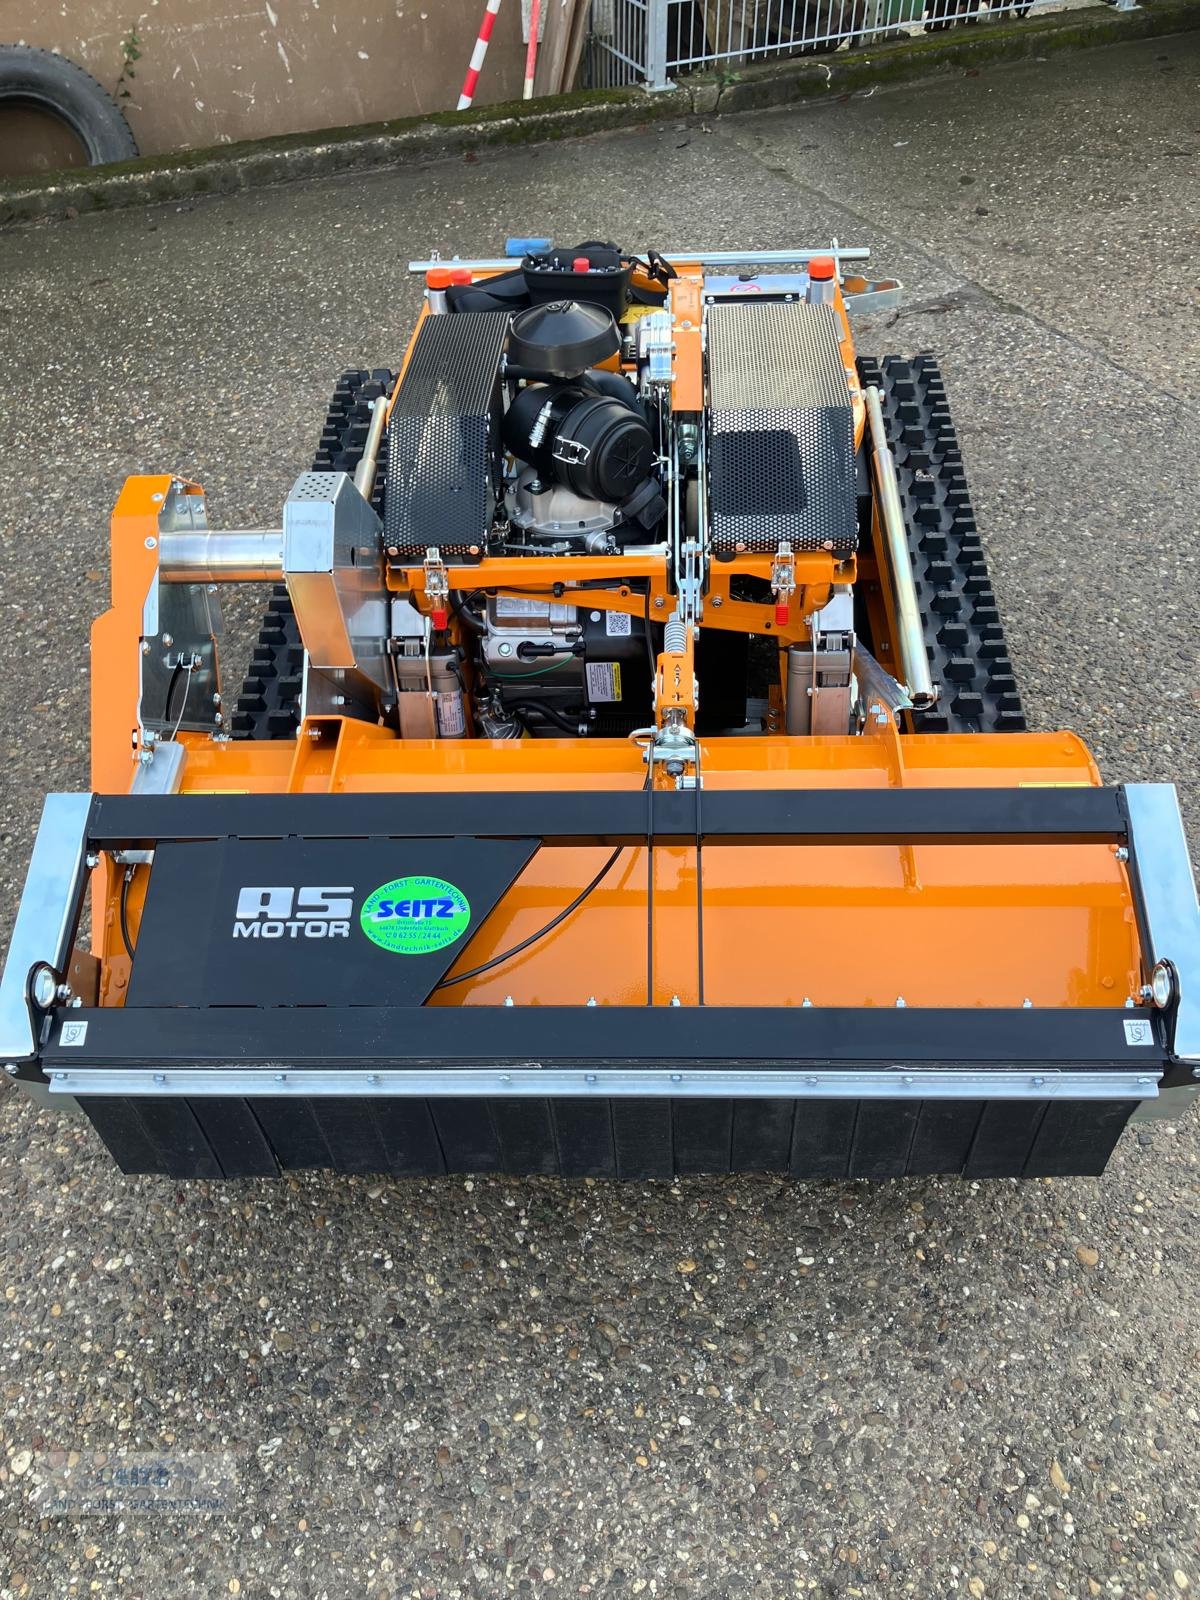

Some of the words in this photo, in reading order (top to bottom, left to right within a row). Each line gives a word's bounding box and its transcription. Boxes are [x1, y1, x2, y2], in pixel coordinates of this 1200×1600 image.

[235, 886, 355, 919] AS
[364, 894, 381, 914] LAND
[383, 879, 409, 894] FORST
[414, 878, 468, 913] GARTENTECHNIK
[377, 899, 455, 918] SEITZ
[232, 921, 351, 938] MOTOR
